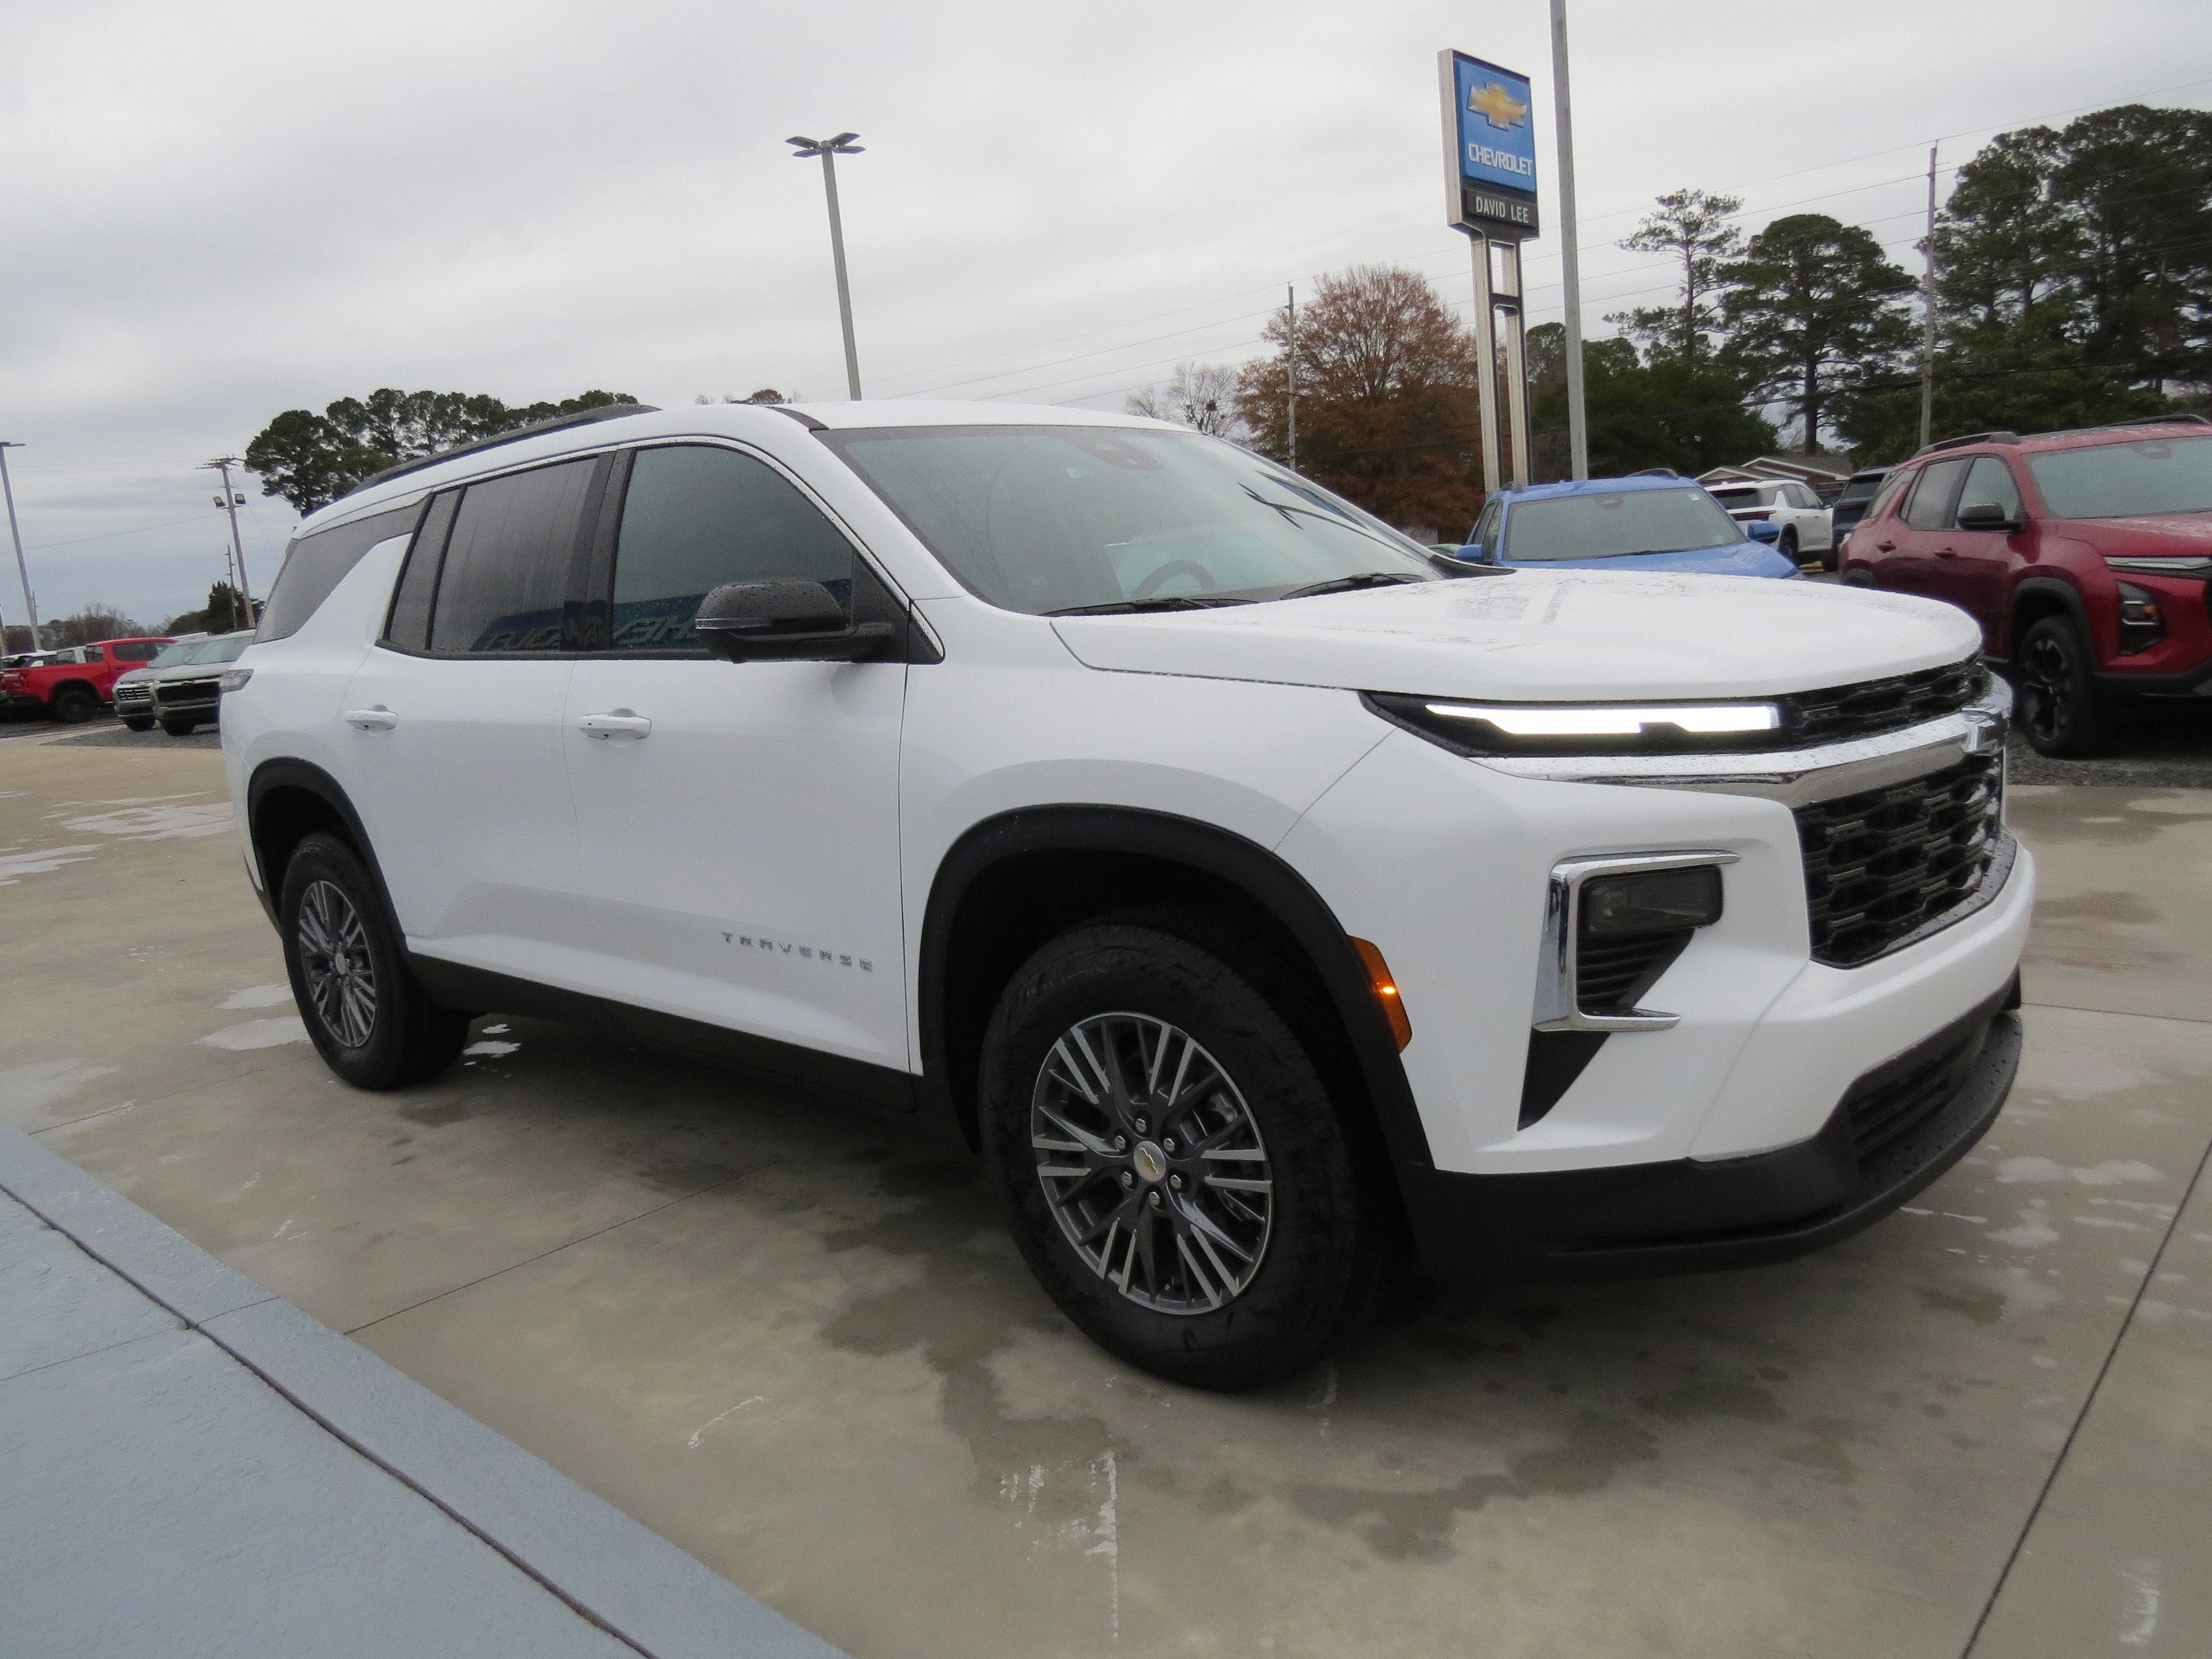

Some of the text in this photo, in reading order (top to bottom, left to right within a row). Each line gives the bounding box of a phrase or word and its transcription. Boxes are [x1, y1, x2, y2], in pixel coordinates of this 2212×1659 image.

[1468, 142, 1532, 176] CHEVROLET
[1475, 196, 1530, 224] DAVID LEE
[721, 931, 873, 972] TRAVERSE
